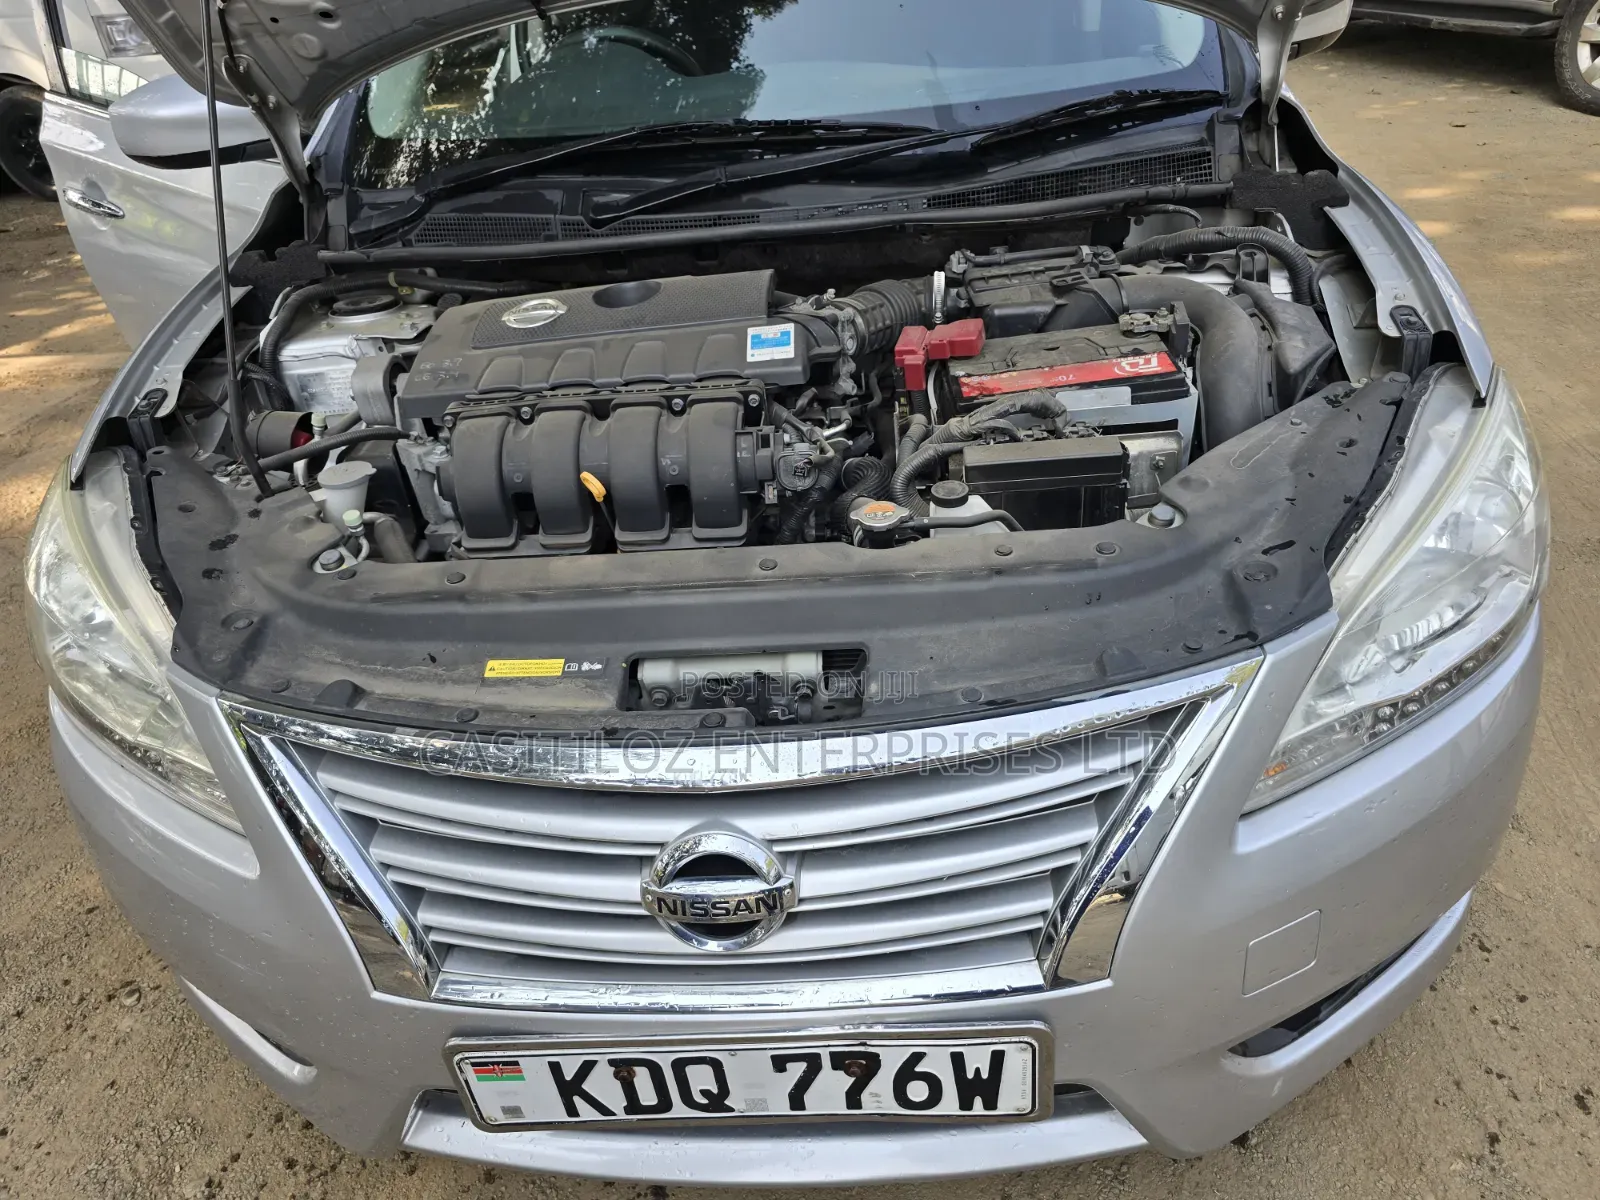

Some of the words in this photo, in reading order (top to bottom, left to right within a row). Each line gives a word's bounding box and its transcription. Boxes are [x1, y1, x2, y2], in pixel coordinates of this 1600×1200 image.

[656, 894, 784, 918] NISSAN
[547, 1056, 736, 1118] KDQ
[770, 1049, 1006, 1111] 776W
